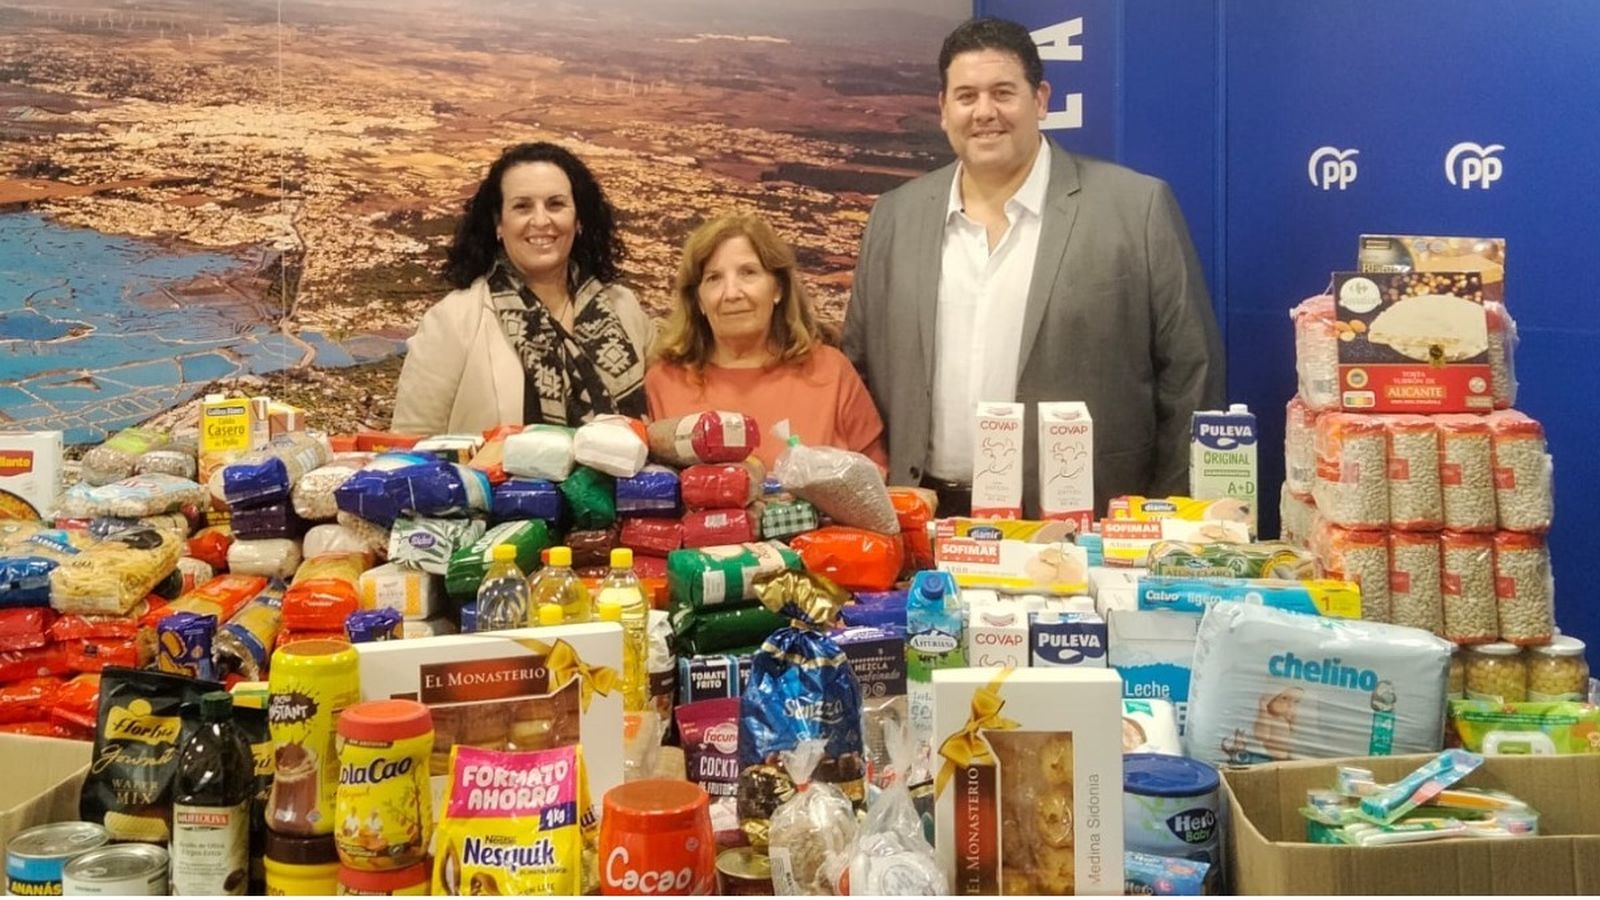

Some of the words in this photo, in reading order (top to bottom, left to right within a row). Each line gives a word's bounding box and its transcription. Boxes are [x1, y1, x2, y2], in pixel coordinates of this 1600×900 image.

[1387, 386, 1444, 398] ALICANTE
[208, 424, 245, 437] Casero
[980, 420, 1019, 431] COVAP
[1049, 425, 1088, 435] COVAP
[1200, 424, 1253, 437] PULEVA
[1203, 451, 1250, 465] ORIGINAL
[1105, 523, 1161, 533] SOFIMAR
[941, 542, 998, 556] SOFIMAR
[1145, 590, 1179, 602] Calvo
[975, 633, 1023, 646] COVAP
[1038, 632, 1101, 648] PULEVA
[854, 661, 889, 671] MEZCLA
[1267, 652, 1379, 692] chelino
[424, 674, 443, 689] EL
[447, 667, 546, 687] MONASTERIO
[691, 669, 727, 682] TOMATE
[695, 680, 722, 690] FRITO
[1125, 681, 1170, 698] Leche
[704, 730, 736, 743] facun
[339, 757, 412, 785] olaCao
[462, 760, 569, 788] FORMATO
[116, 791, 154, 805] MIX
[467, 785, 560, 811] AHORRO
[1087, 774, 1102, 829] Sidonia
[965, 767, 981, 871] MONASTERIO
[1173, 810, 1215, 831] Hero
[463, 836, 555, 873] Nesquik
[605, 846, 693, 894] Cacao
[966, 877, 981, 894] EL
